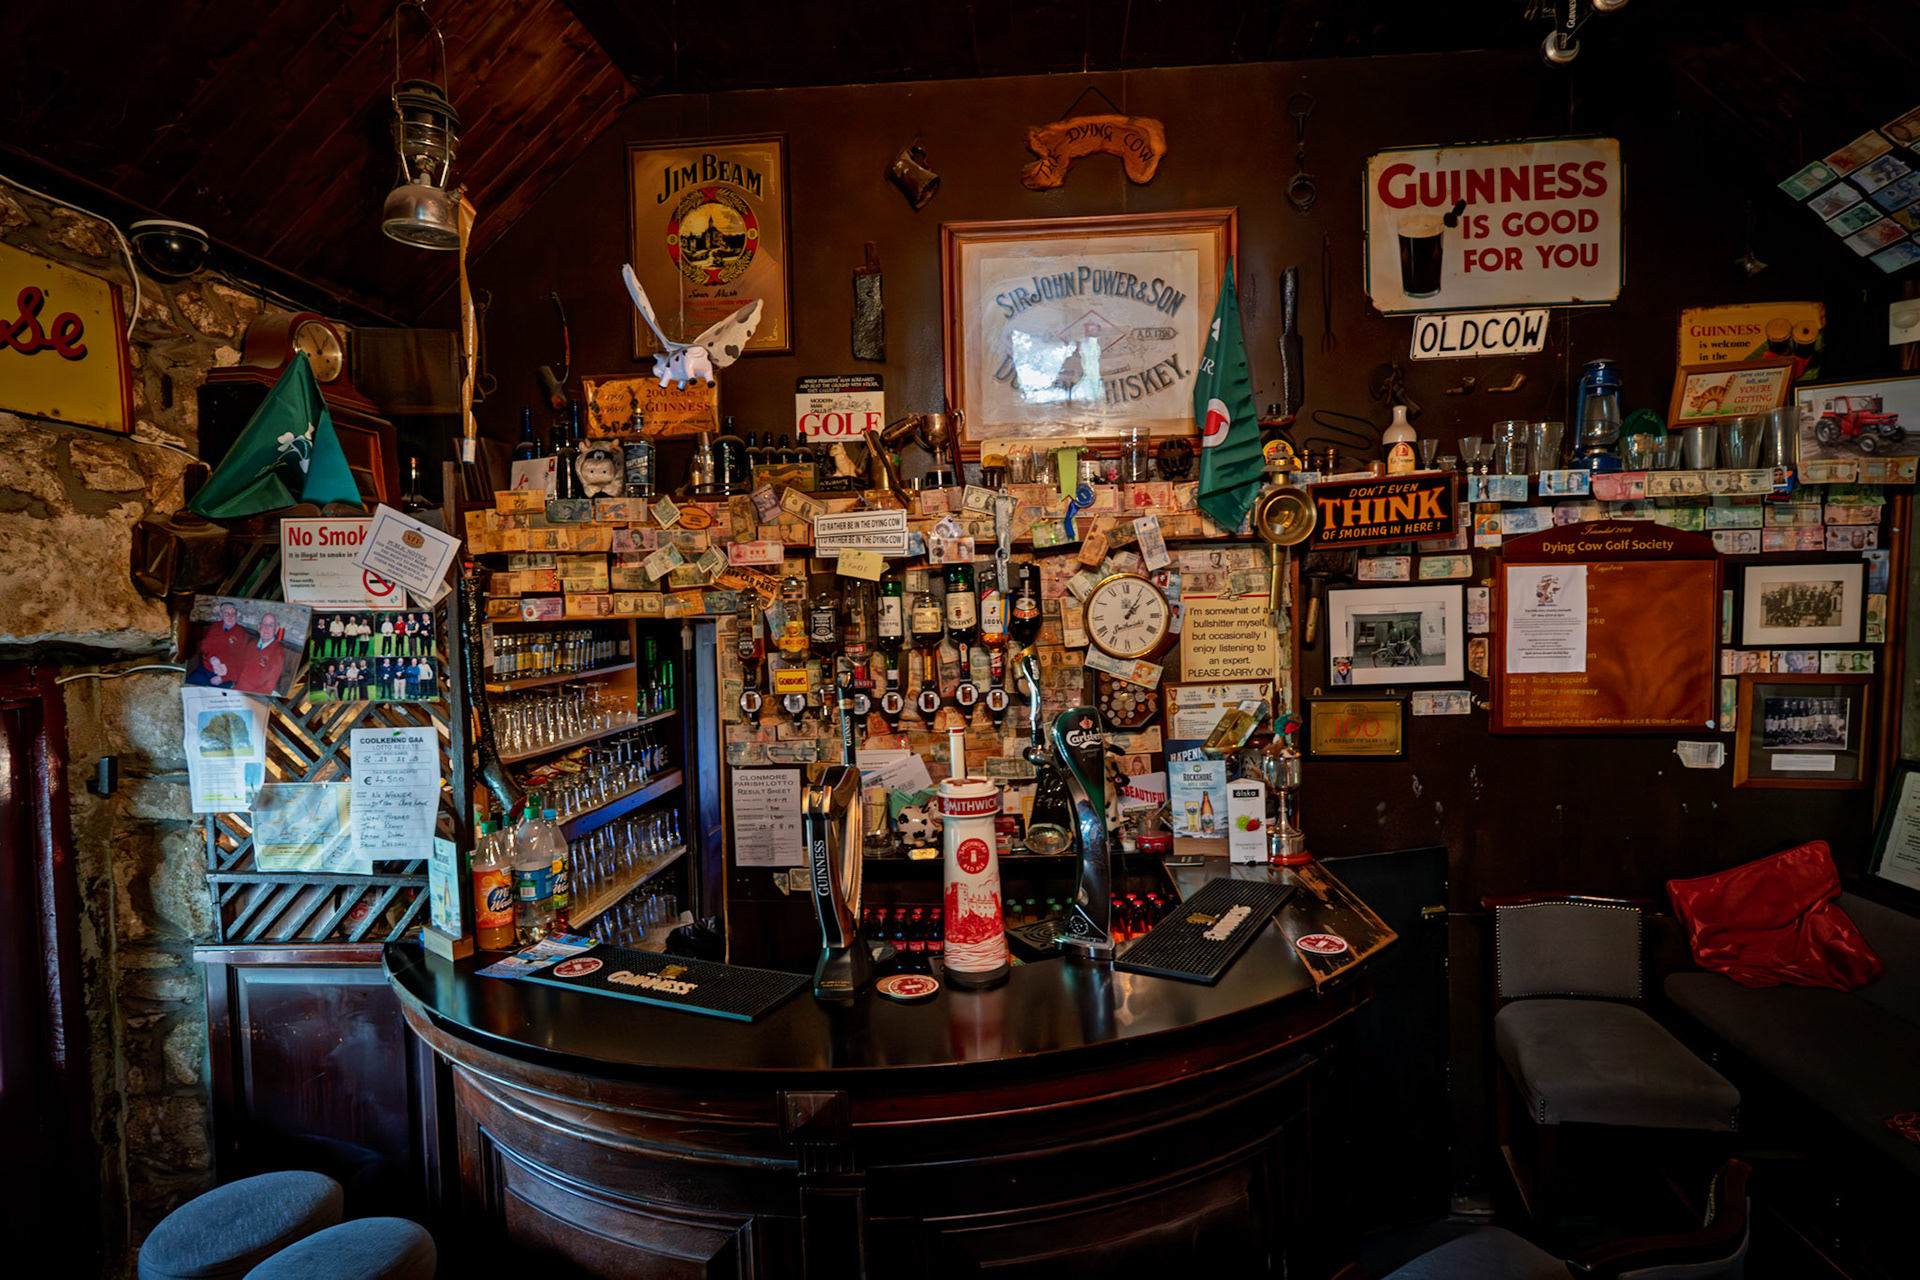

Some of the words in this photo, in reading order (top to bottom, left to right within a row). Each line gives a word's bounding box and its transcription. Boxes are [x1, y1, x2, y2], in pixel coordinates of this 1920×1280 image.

[1035, 152, 1061, 179] THE
[1066, 123, 1113, 144] DYING
[1123, 132, 1155, 163] COW
[657, 162, 698, 205] JIM
[702, 154, 763, 201] BEAM
[1377, 160, 1608, 210] GUINNESS
[1463, 214, 1490, 240] IS
[1501, 209, 1600, 238] GOOD
[1463, 247, 1524, 273] FOR
[1535, 243, 1600, 269] YOU
[996, 287, 1032, 319] SIR
[1026, 271, 1078, 304] JOHN
[1077, 266, 1137, 297] POWER
[1136, 282, 1148, 301] &
[1145, 278, 1187, 317] SON
[1419, 314, 1544, 355] OLDCOW
[1690, 324, 1761, 338] GUINNESS
[1699, 340, 1708, 348] is
[1710, 339, 1750, 348] welcome
[1699, 353, 1709, 361] in
[1712, 352, 1728, 361] the
[645, 388, 667, 398] 200
[645, 401, 711, 413] GUINNESS
[799, 412, 882, 437] GOLF
[1349, 485, 1386, 498] DON'T
[1387, 483, 1419, 494] EVEN
[1317, 486, 1448, 530] THINK
[826, 521, 847, 531] RATHER
[847, 520, 854, 530] BE
[854, 520, 861, 529] IN
[861, 519, 871, 529] THE
[871, 518, 888, 528] DYING
[888, 518, 900, 527] COW
[1322, 530, 1337, 540] OF
[1338, 526, 1387, 539] SMOKING
[1390, 525, 1400, 534] IN
[1404, 521, 1434, 534] HERE
[288, 526, 313, 547] No
[1542, 541, 1576, 554] Dying
[1577, 540, 1602, 551] Cow
[1605, 539, 1630, 550] Golf
[1631, 538, 1675, 551] Society
[300, 551, 318, 560] illegal
[1189, 607, 1203, 616] I'm
[1205, 607, 1249, 615] somewhat
[1251, 606, 1260, 614] of
[1193, 619, 1234, 628] bullshitter
[1236, 619, 1267, 629] myself,
[1192, 632, 1206, 641] but
[1208, 631, 1261, 641] occasionally
[1264, 631, 1267, 639] I
[1192, 645, 1217, 654] enjoy
[1219, 644, 1255, 653] listening
[1222, 656, 1251, 666] expert.
[1188, 669, 1220, 677] PLEASE
[1222, 668, 1254, 677] CARRY
[1255, 667, 1273, 676] ON!
[1335, 716, 1381, 738] 100
[408, 736, 424, 744] GAA
[1183, 773, 1213, 781] ROCKSHORE
[813, 839, 830, 897] GUINNESS
